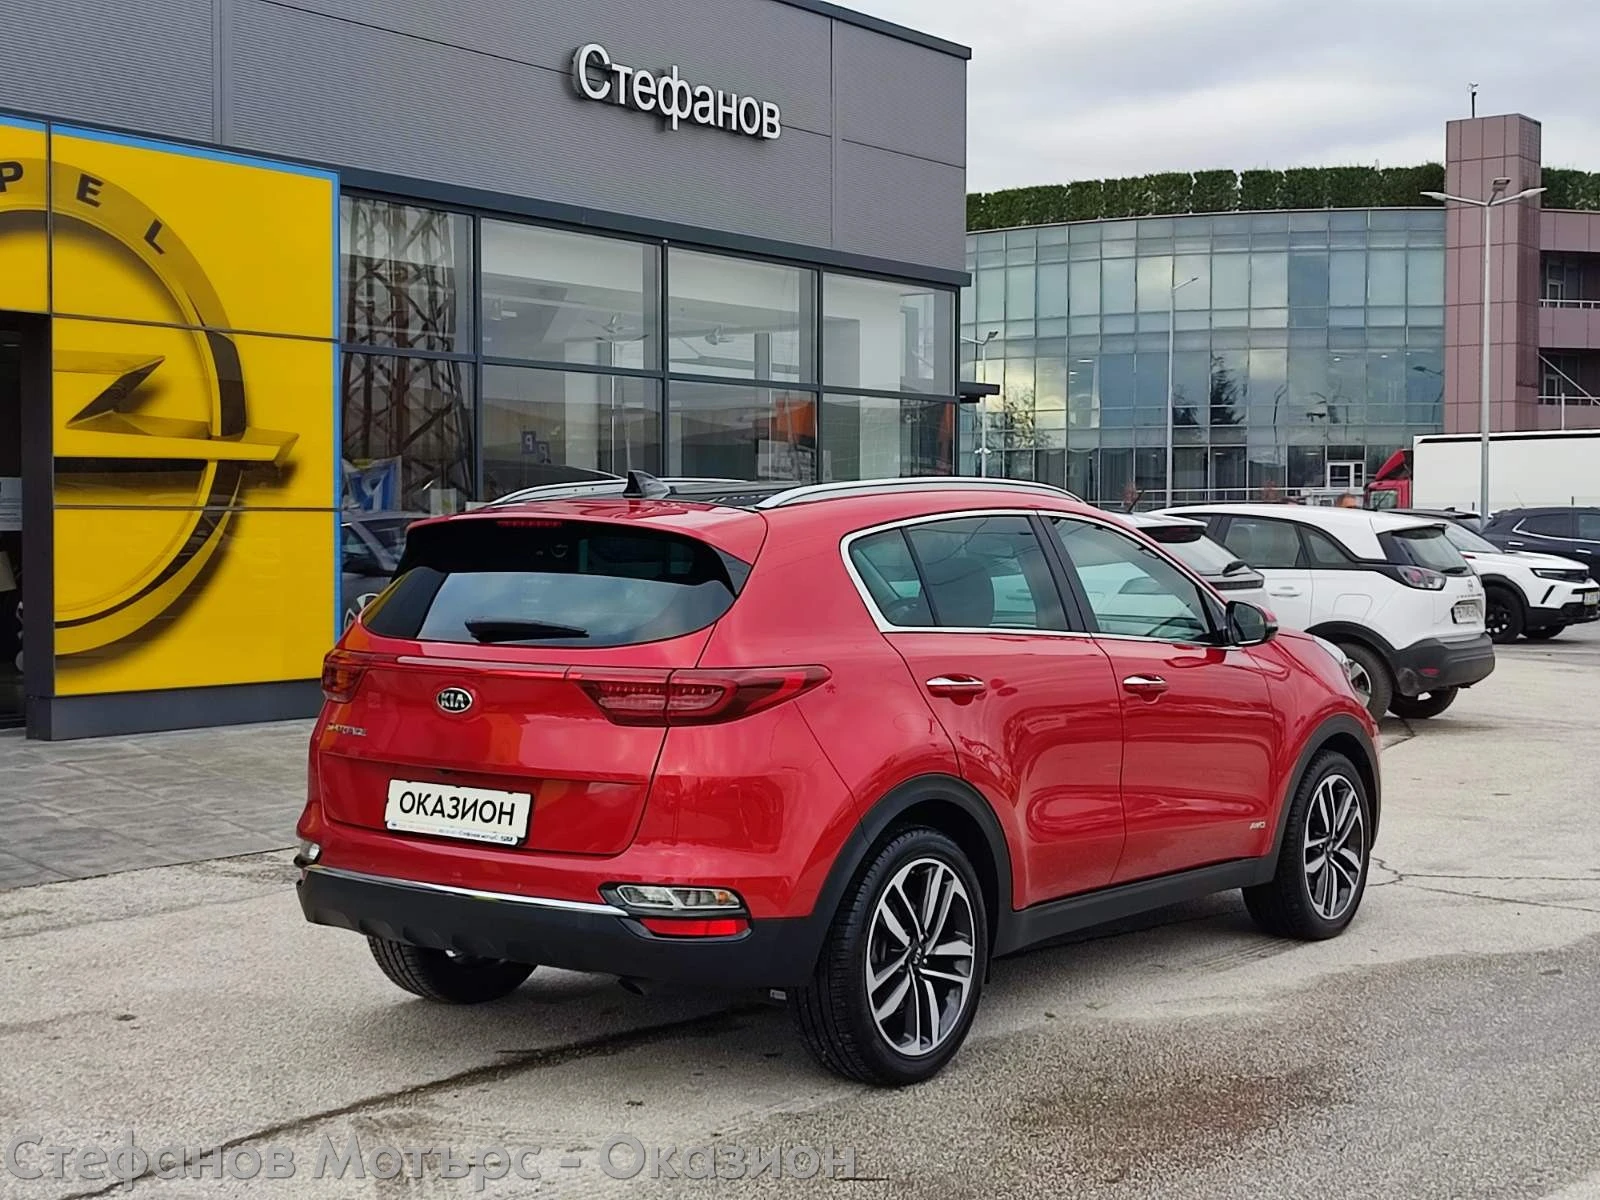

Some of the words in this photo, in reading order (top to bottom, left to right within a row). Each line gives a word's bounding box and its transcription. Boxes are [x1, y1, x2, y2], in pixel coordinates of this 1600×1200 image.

[576, 43, 781, 139] Стефанов
[441, 693, 465, 708] KIA
[400, 791, 515, 825] ОКАЗИОН
